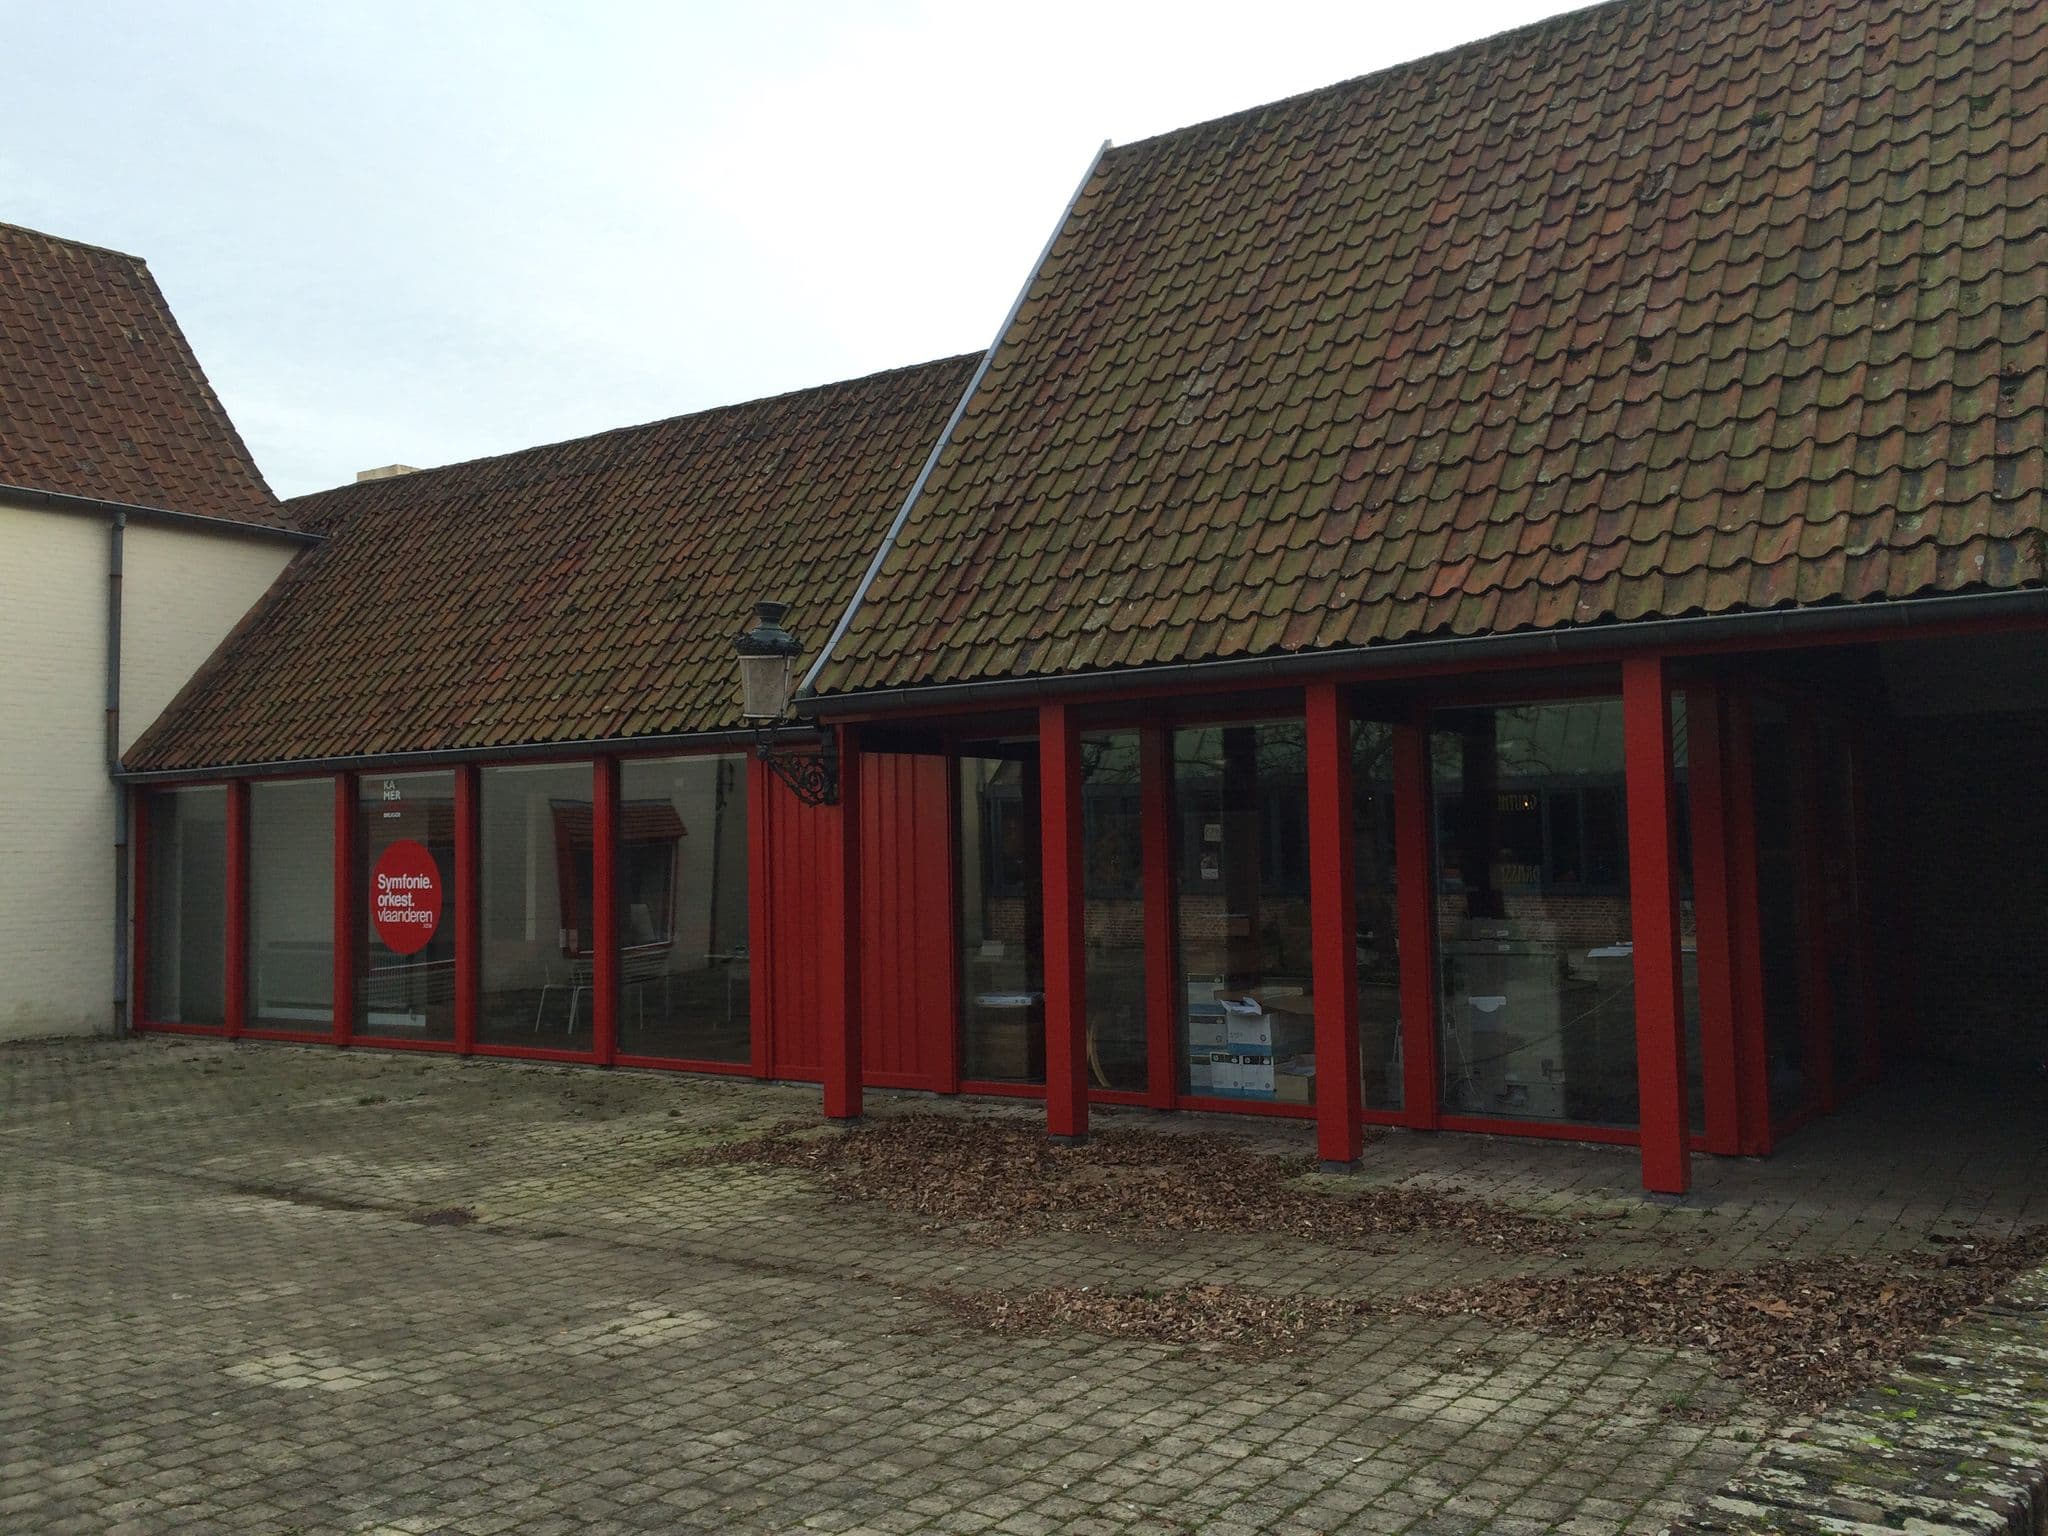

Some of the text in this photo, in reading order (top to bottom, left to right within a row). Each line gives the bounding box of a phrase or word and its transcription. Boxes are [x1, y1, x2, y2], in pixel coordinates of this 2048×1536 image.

[383, 780, 396, 790] KA
[383, 790, 401, 801] MER
[377, 873, 433, 893] Symfonie.
[377, 891, 415, 907] orkest.
[377, 907, 433, 923] vlaanderen
